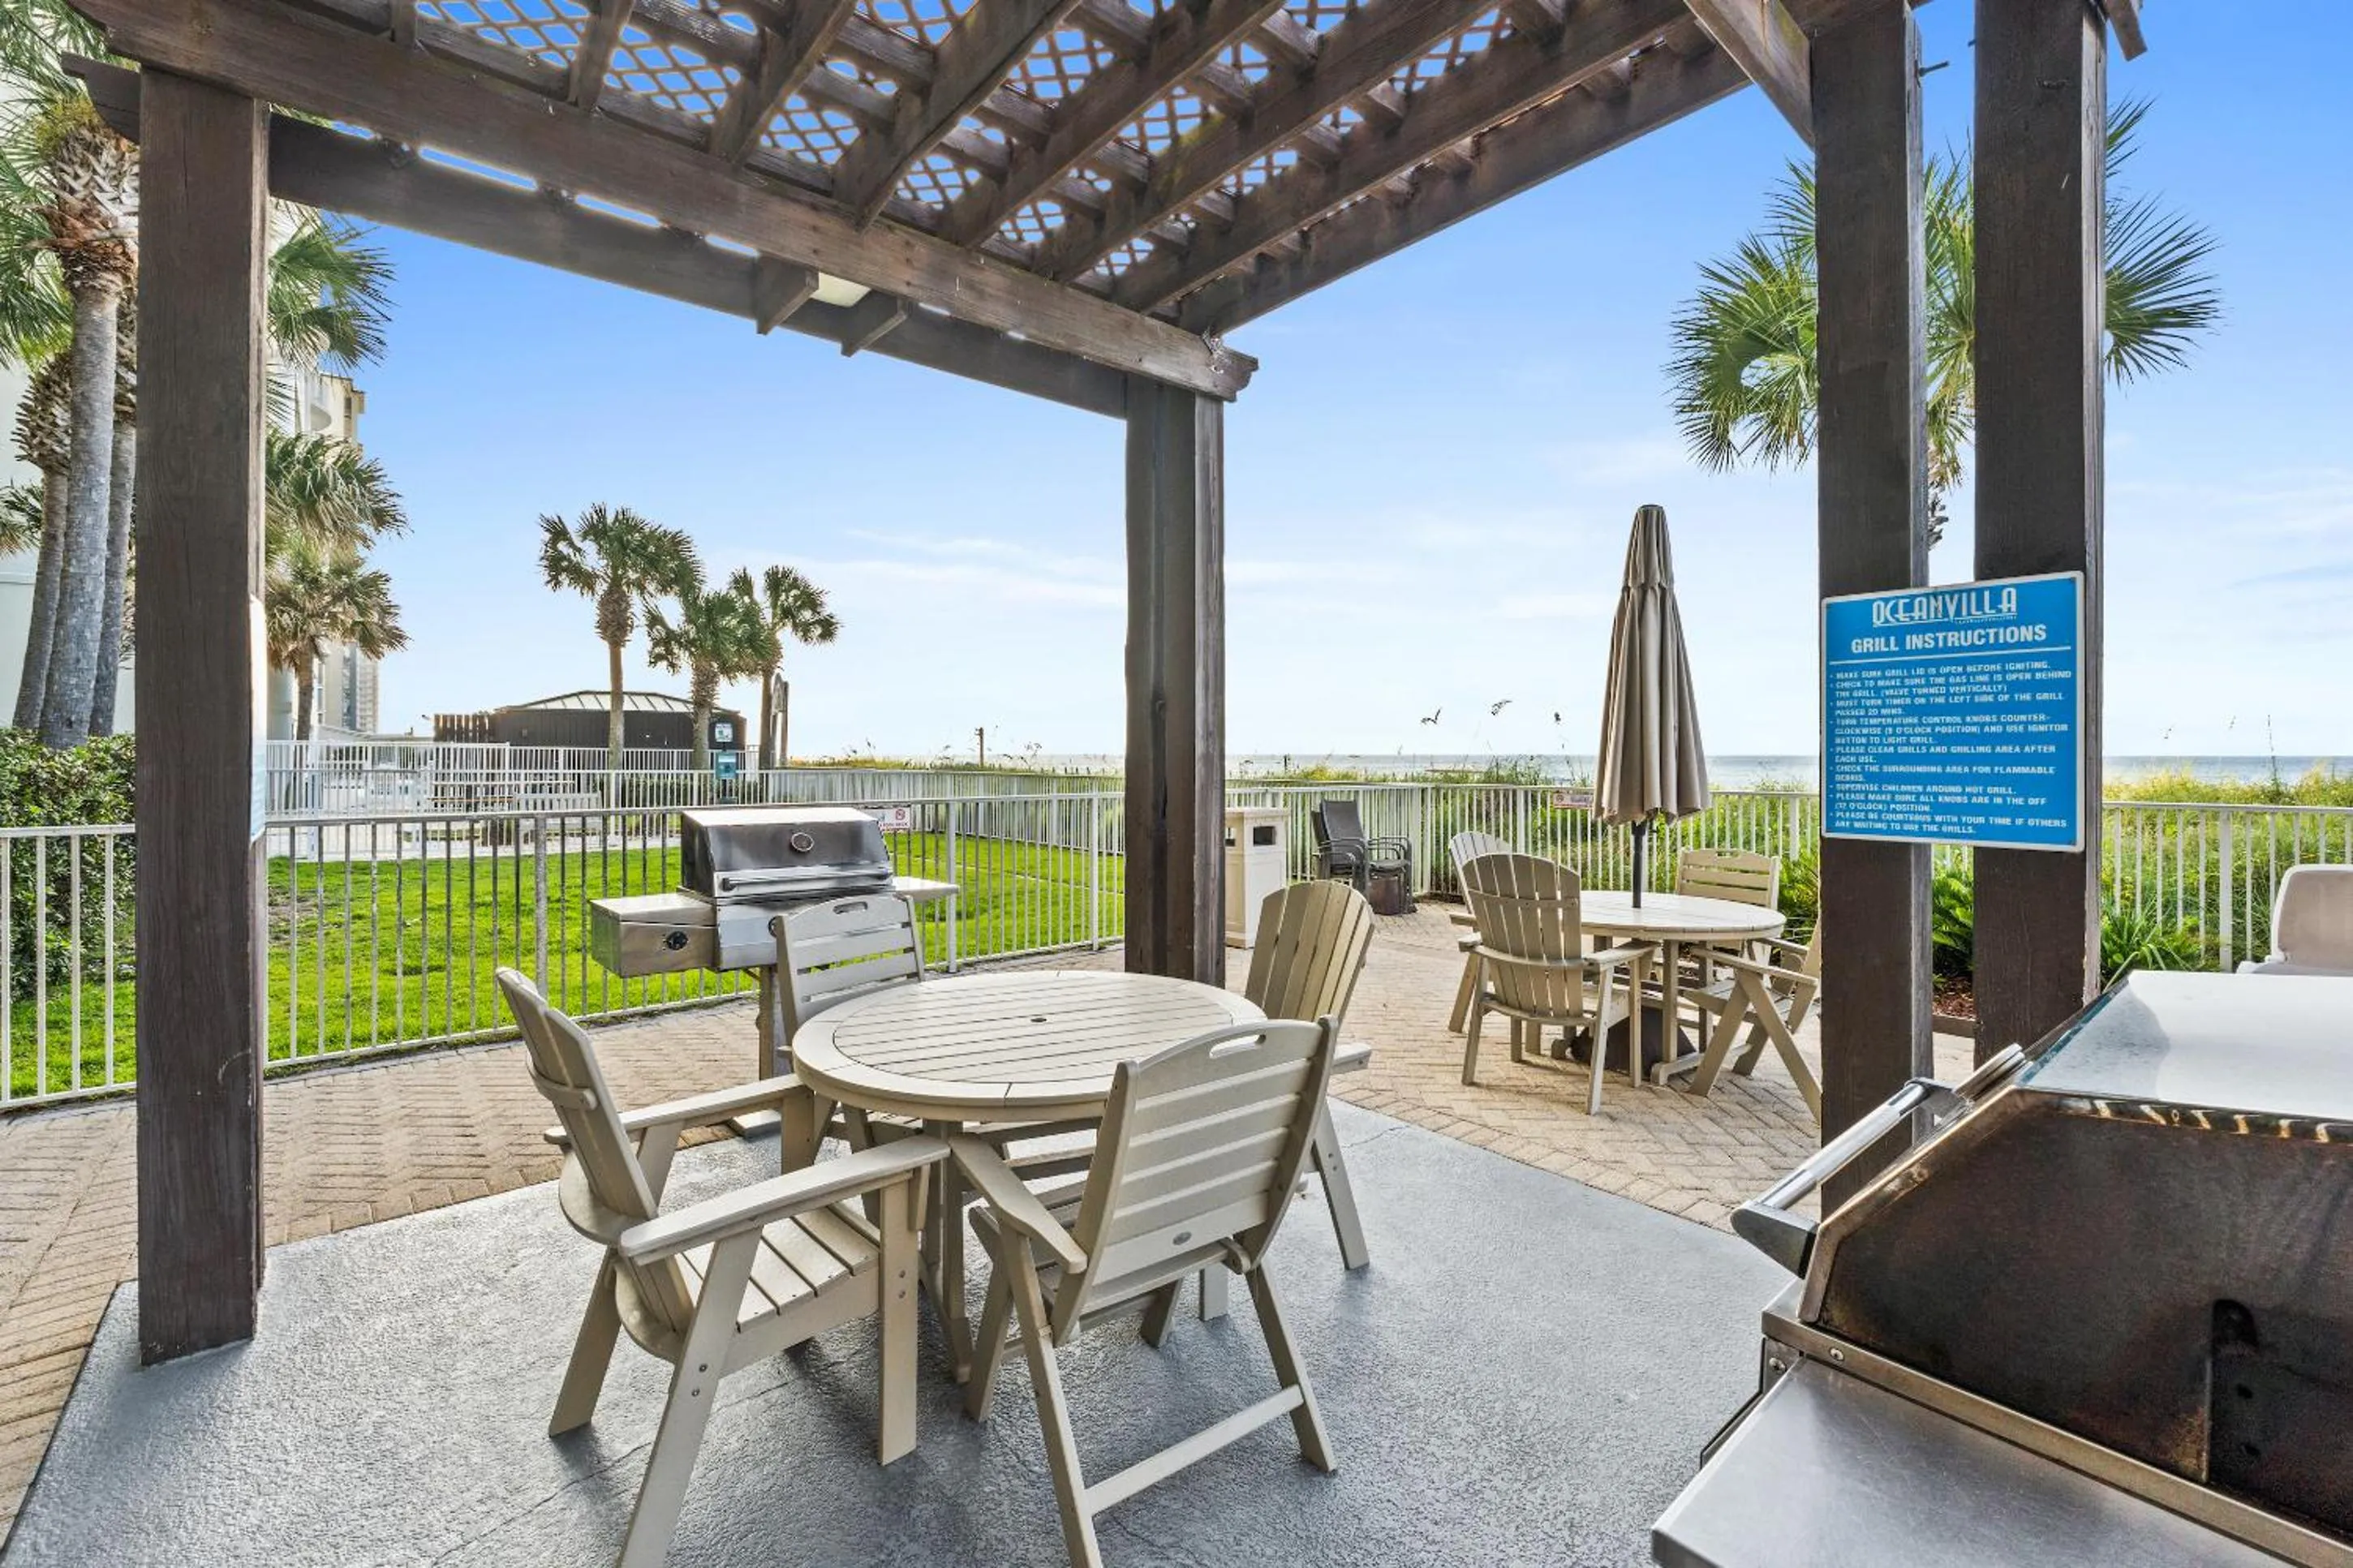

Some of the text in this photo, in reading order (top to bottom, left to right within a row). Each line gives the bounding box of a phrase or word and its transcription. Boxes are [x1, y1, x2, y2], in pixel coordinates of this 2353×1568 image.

[1873, 587, 2017, 625] OCEANVILLA
[1852, 625, 2046, 653] GRILL INSTRUCTIONS
[1967, 664, 2003, 672] BEFORE
[2006, 661, 2051, 671] IGNITING.
[2007, 672, 2031, 681] OPEN
[2036, 671, 2071, 680] BEHIND
[1950, 685, 2007, 694] VERTICALLY)
[1950, 695, 1970, 703] LEFT
[1998, 694, 2010, 702] OF
[2015, 693, 2032, 701] THE
[2036, 692, 2064, 700] GRILL
[1860, 717, 1918, 725] TEMPERATURE
[2001, 713, 2051, 722] COUNTER-
[1934, 725, 1981, 733] POSITION)
[1984, 725, 2002, 733] AND
[2007, 724, 2024, 732] USE
[1951, 745, 1991, 754] GRILLING
[1995, 745, 2020, 754] AREA
[1972, 766, 1991, 774] FOR
[1972, 796, 1990, 804] ARE
[2028, 797, 2046, 805] OFF
[1989, 817, 2011, 825] TIME
[2028, 818, 2067, 827] OTHERS
[1942, 825, 1976, 833] GRILLS.
